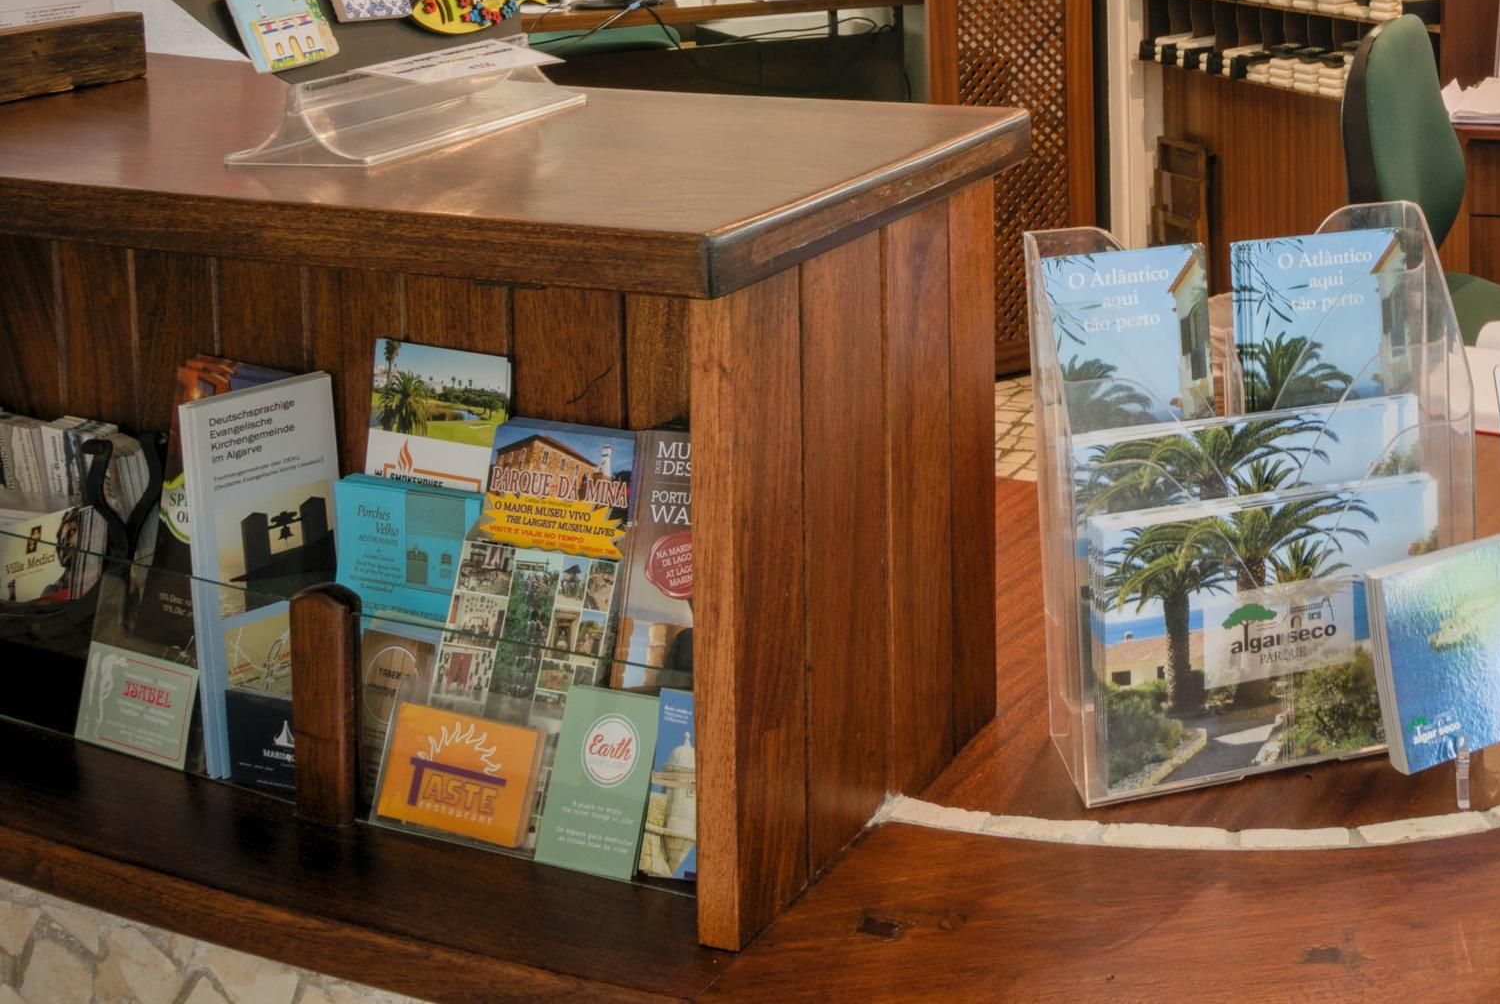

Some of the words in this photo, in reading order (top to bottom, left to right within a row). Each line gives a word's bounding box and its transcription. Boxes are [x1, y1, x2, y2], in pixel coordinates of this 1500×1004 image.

[1278, 252, 1294, 270] O
[1298, 248, 1373, 269] Atlântico
[1068, 272, 1086, 290] O
[1090, 265, 1169, 288] Atlântico
[1308, 271, 1344, 290] aqui
[1102, 290, 1139, 309] aqui
[1322, 292, 1364, 311] perto
[1116, 312, 1161, 333] perto
[208, 400, 295, 427] Deutschsprachige
[210, 417, 273, 439] Evangelische
[211, 424, 295, 452] Kirchengemeinde
[212, 454, 224, 464] im
[226, 444, 263, 460] Algarve
[490, 466, 553, 496] PARQUE
[557, 475, 580, 502] DA
[584, 478, 628, 508] MINA
[357, 504, 391, 520] Porches
[494, 501, 502, 510] O
[504, 502, 534, 515] MAIOR
[534, 506, 567, 519] MUSEU
[569, 510, 591, 522] VIVO
[376, 522, 400, 536] Velho
[490, 524, 513, 534] VISITE
[521, 530, 543, 539] VIAJE
[544, 533, 556, 541] NO
[558, 534, 584, 543] TEMPO
[506, 514, 521, 524] THE
[522, 517, 557, 529] LARGEST
[558, 522, 592, 534] MUSEUM
[593, 527, 616, 538] LIVES
[5, 560, 25, 576] Villa
[26, 553, 56, 570] Medici
[656, 550, 668, 560] NA
[662, 558, 672, 568] DE
[666, 569, 675, 579] AT
[1230, 630, 1282, 654] algar
[1287, 624, 1337, 644] seco
[1260, 646, 1307, 664] PARQUE
[1413, 728, 1437, 745] algar
[1439, 722, 1461, 736] seco
[588, 734, 633, 761] Earth
[406, 756, 507, 817] TASTE
[418, 799, 494, 826] restaurant
[578, 802, 595, 812] place
